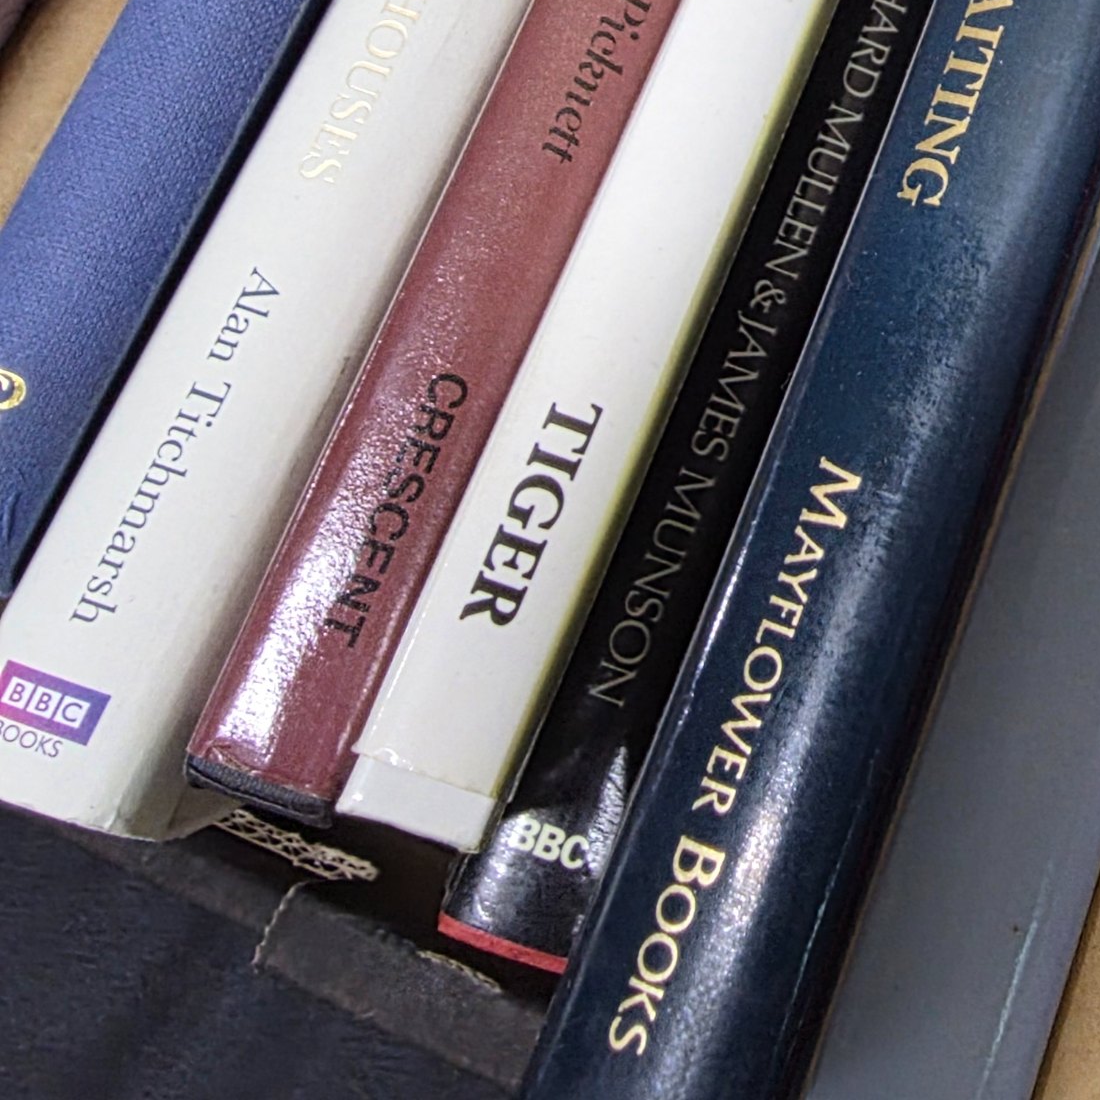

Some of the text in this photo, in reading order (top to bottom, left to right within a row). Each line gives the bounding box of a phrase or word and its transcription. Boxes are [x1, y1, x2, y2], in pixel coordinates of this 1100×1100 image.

[765, 103, 864, 280] MULLEN
[691, 310, 778, 462] JAMES
[749, 279, 786, 313] &
[70, 266, 281, 625] Alan Titchmarsh
[324, 373, 468, 650] CRESCENT
[458, 402, 603, 627] TIGER
[588, 467, 717, 708] MUNSON
[8, 682, 83, 723] BBC
[609, 456, 863, 1057] MAYFLOWER BOOKS
[508, 813, 590, 870] BBC
